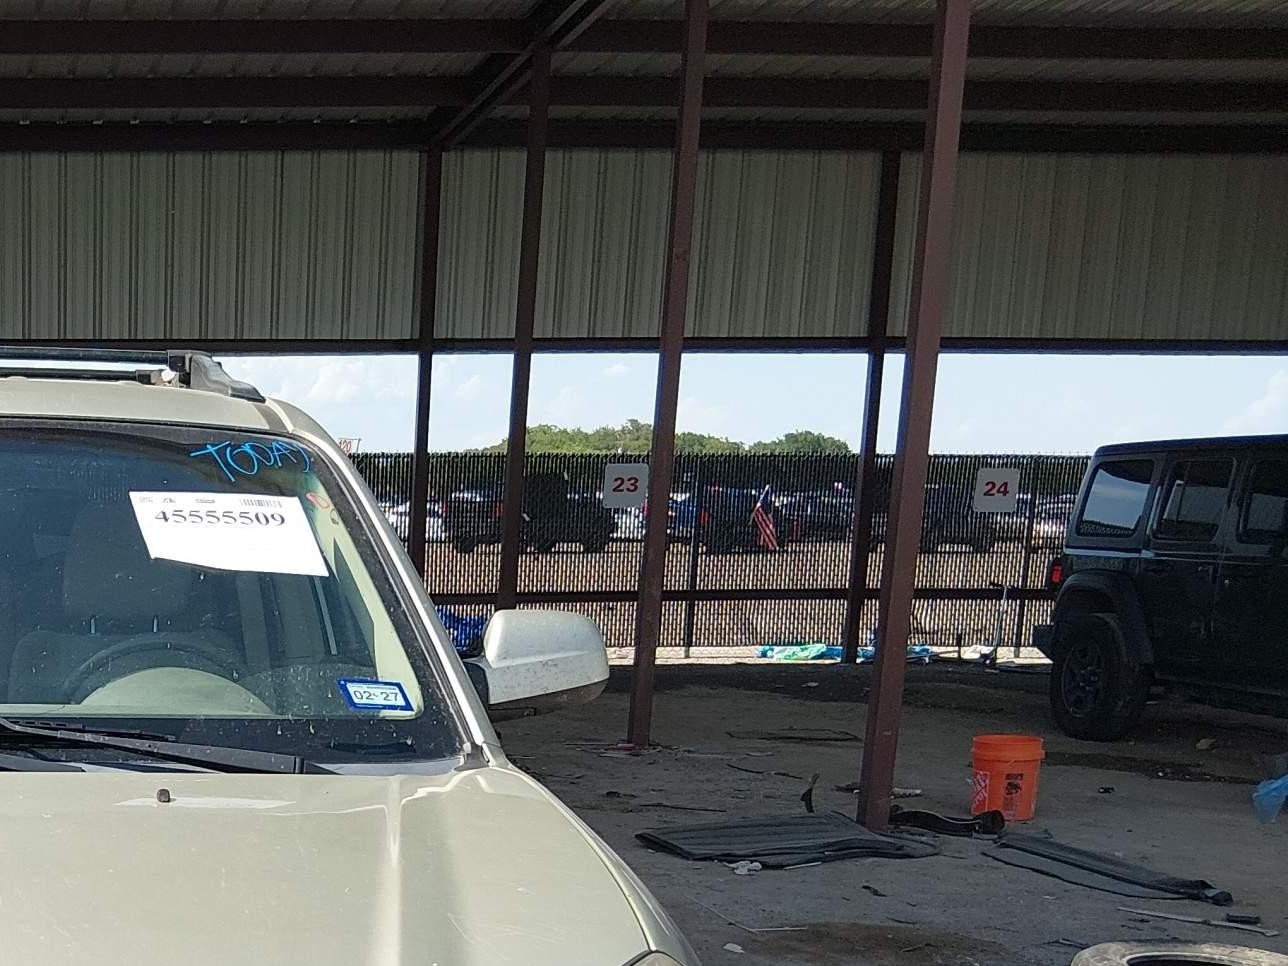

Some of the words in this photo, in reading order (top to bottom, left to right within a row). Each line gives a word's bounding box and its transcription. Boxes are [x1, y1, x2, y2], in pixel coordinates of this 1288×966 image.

[189, 440, 311, 483] TODAY
[612, 476, 639, 492] 23
[983, 480, 1009, 497] 24
[155, 509, 285, 526] 45555509
